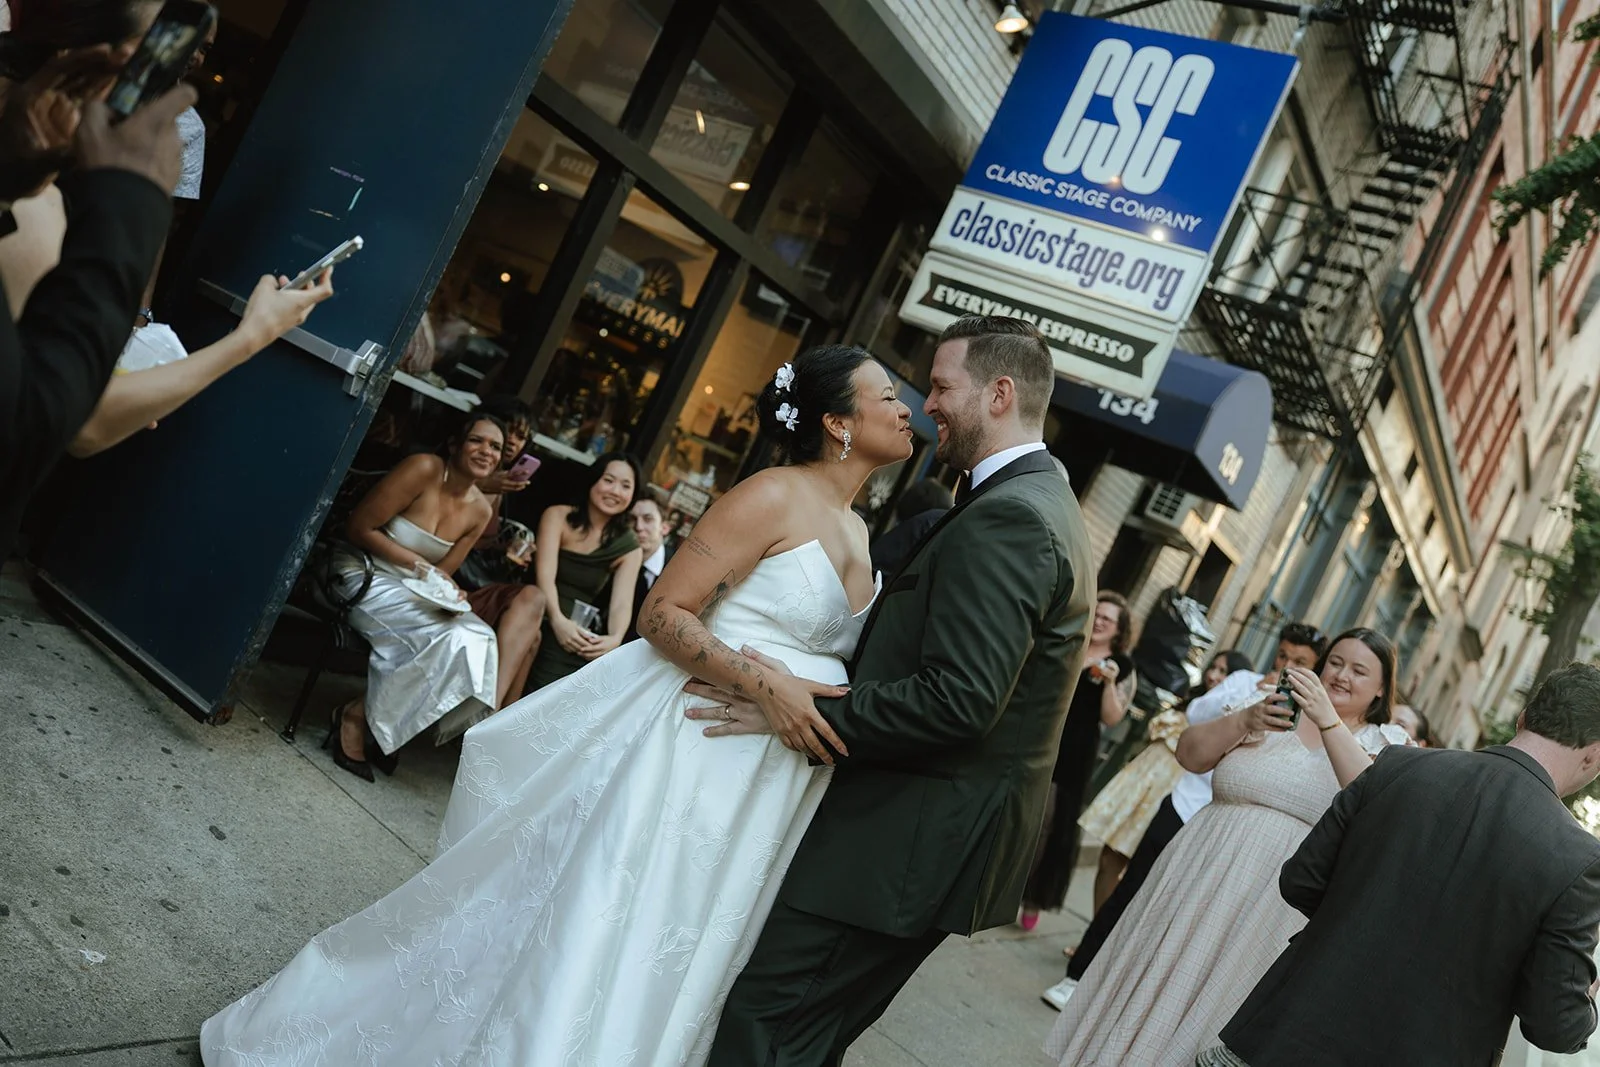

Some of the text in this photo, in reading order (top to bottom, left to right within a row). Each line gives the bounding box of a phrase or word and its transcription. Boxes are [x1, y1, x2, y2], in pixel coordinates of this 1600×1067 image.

[1043, 38, 1215, 195] CSC
[985, 164, 1203, 232] CLASSIC STAGE COMPANY
[949, 201, 1186, 312] classicstage.org
[1038, 317, 1136, 363] ESPRESSO
[1098, 388, 1159, 425] 134
